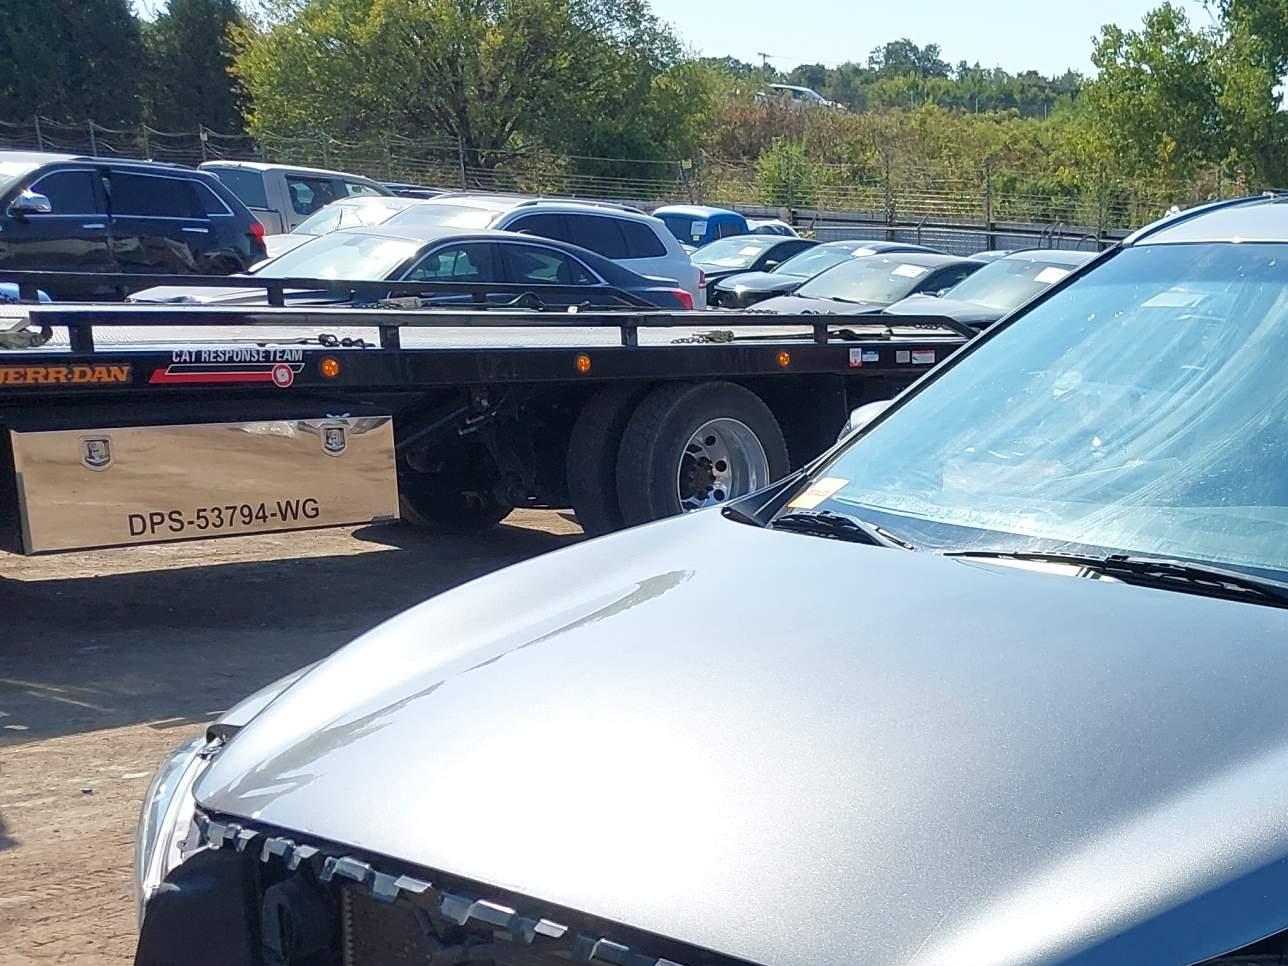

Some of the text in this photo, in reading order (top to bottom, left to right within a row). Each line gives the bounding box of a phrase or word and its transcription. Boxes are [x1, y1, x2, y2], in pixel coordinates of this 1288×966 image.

[171, 349, 303, 363] CAT RESPONSE TEAM
[128, 498, 320, 537] DPS-53794-WG
